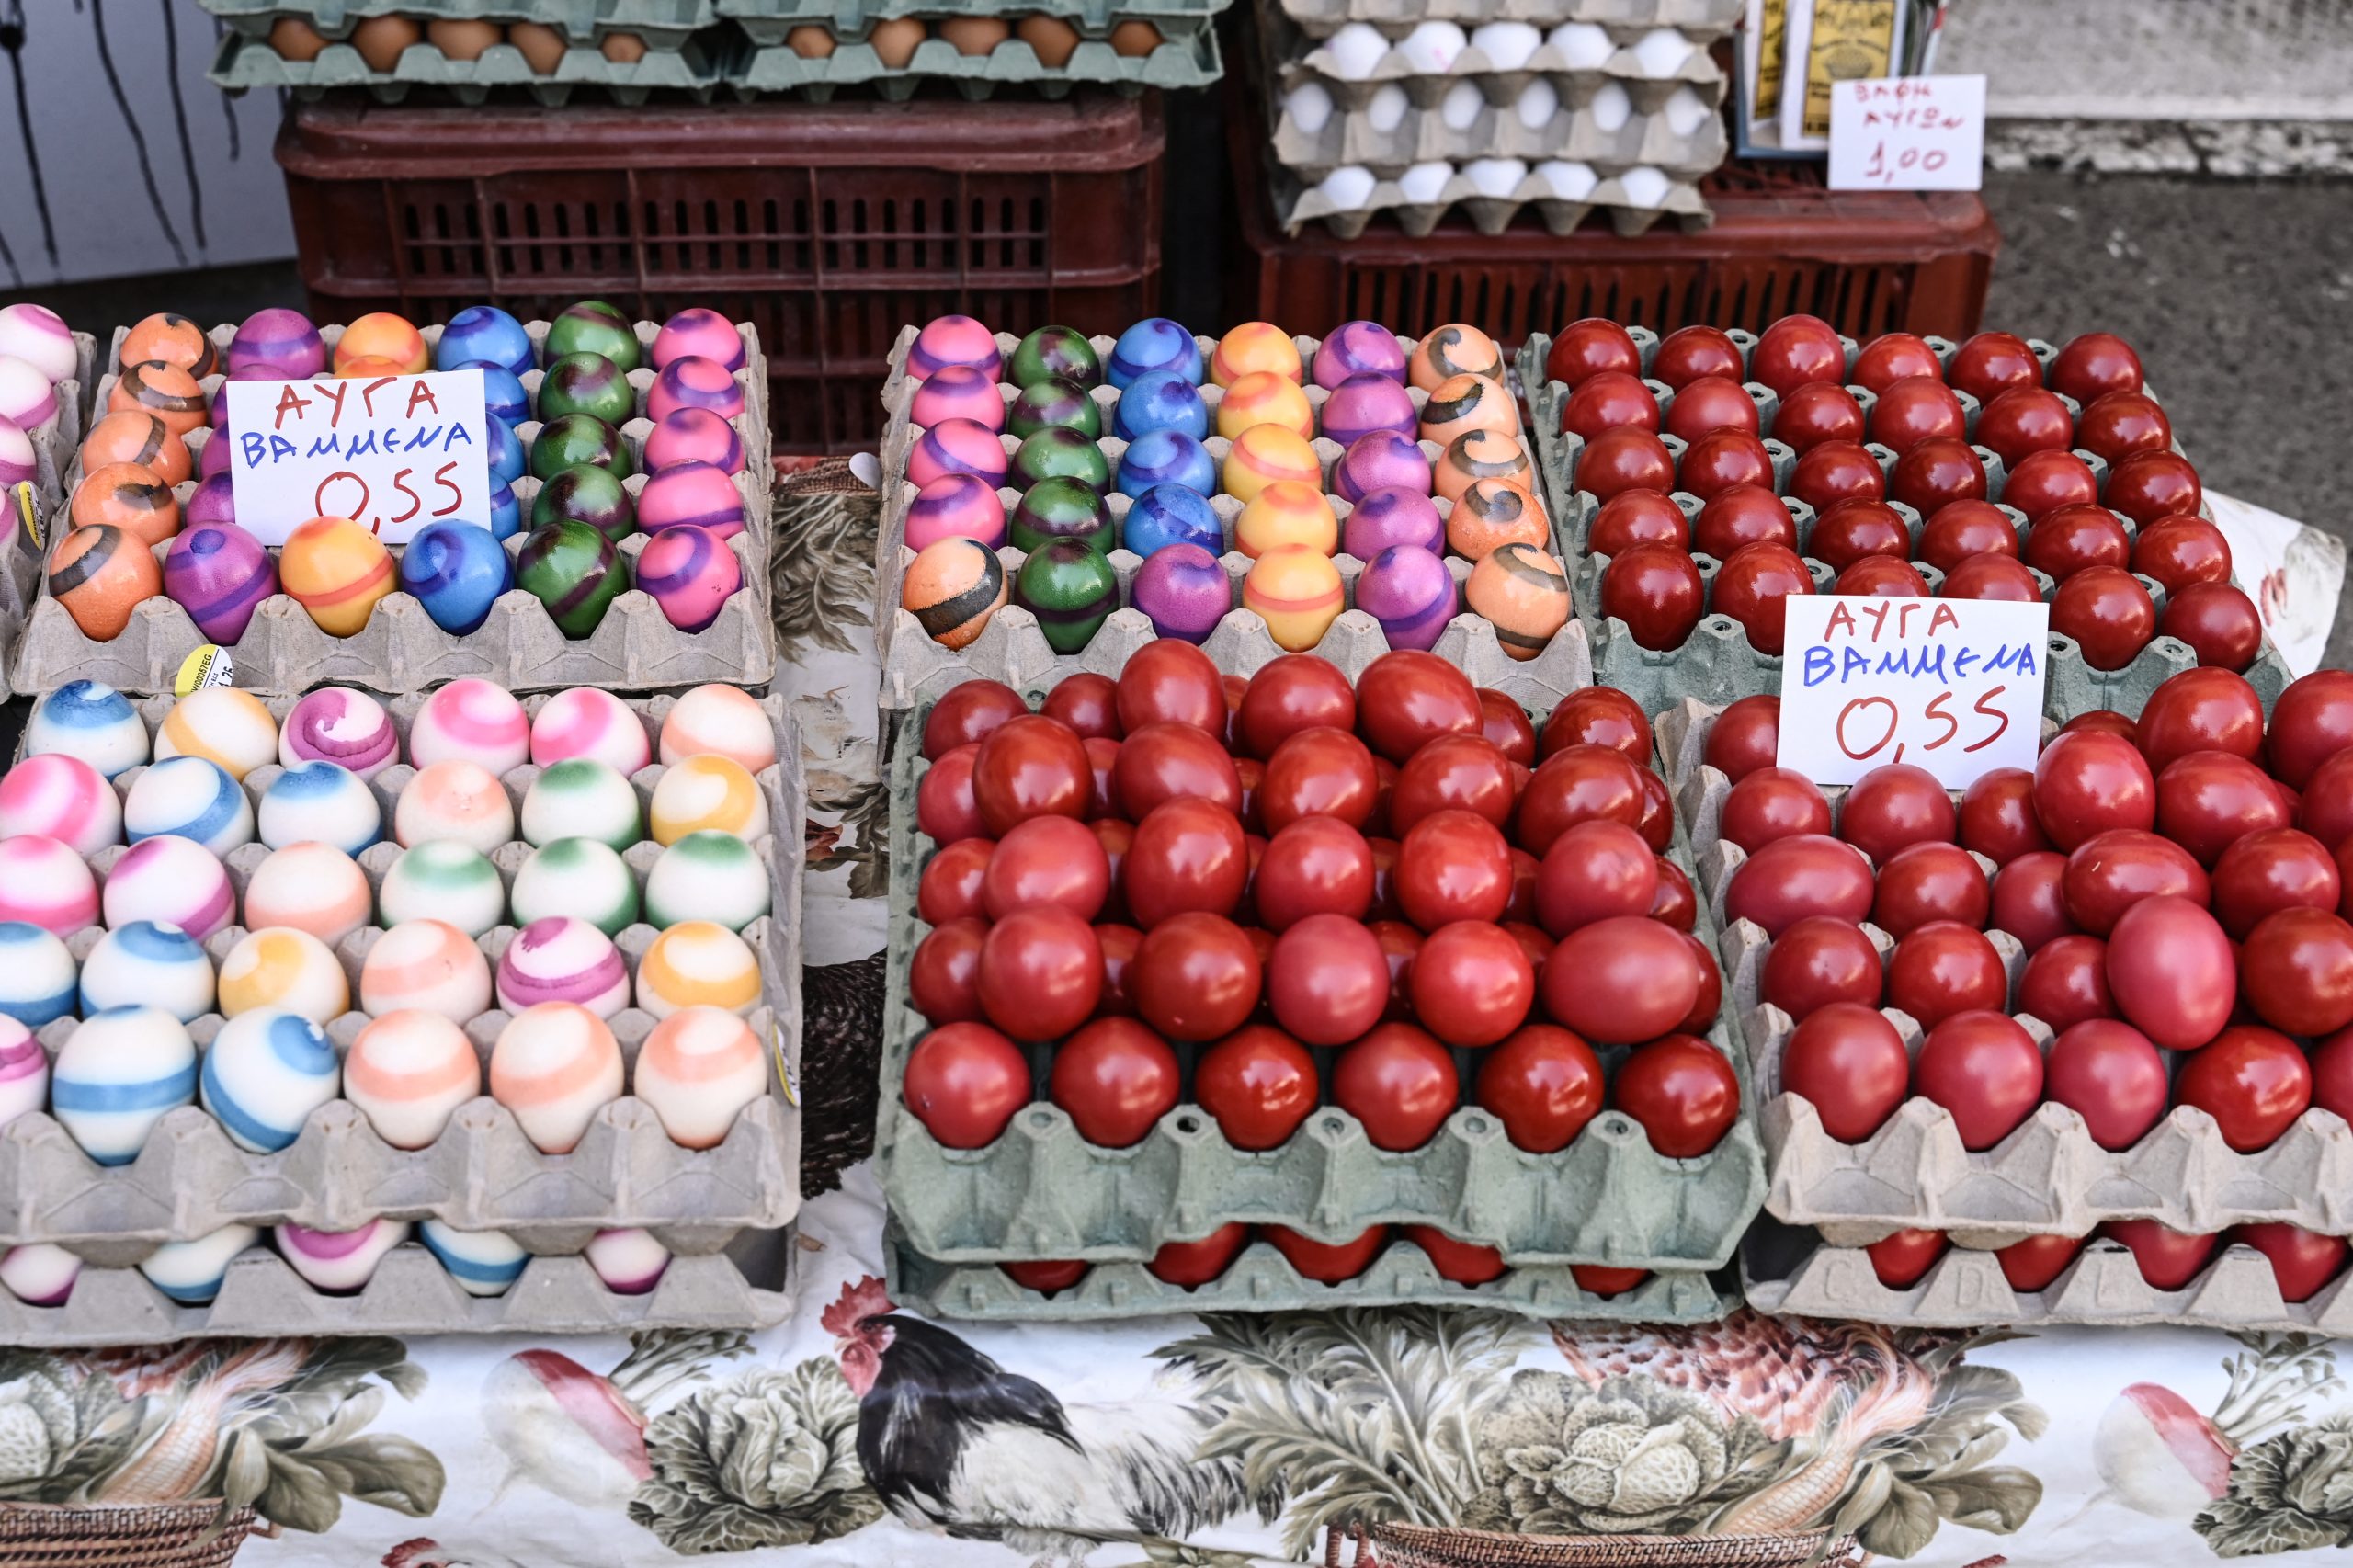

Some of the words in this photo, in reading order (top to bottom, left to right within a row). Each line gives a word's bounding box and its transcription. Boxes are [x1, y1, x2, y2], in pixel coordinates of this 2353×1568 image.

[1866, 140, 1948, 183] 1,00
[275, 377, 438, 430] ΑΥΓΑ
[240, 422, 472, 469] ΒΑΜΜΕΝΑ
[314, 461, 463, 536] 0,55
[1824, 600, 1959, 642] ΑΥΓΑ
[1803, 642, 2036, 687] ΒΑΜΜΕΝΑ
[1836, 685, 2009, 764] 0,55
